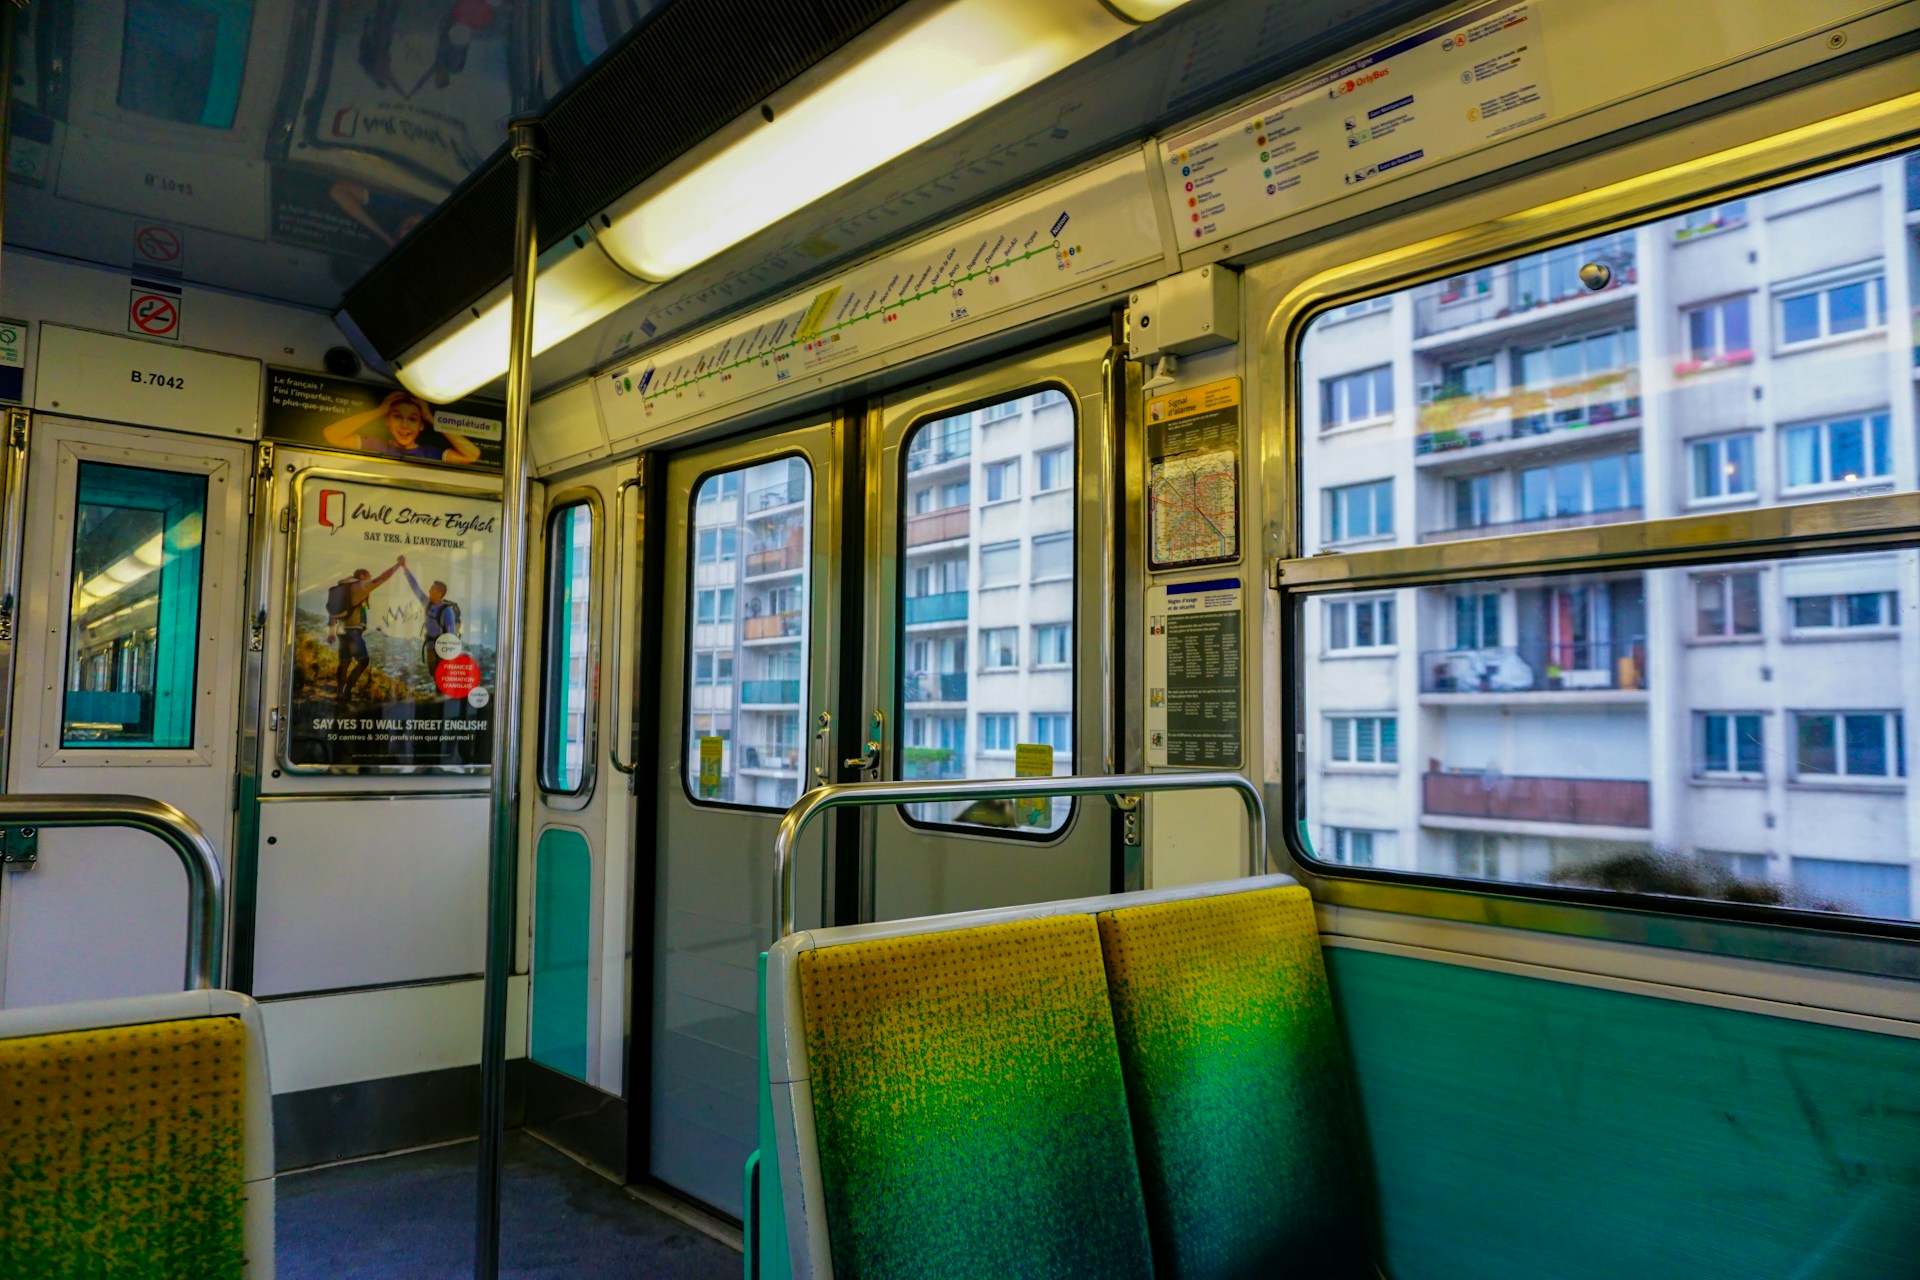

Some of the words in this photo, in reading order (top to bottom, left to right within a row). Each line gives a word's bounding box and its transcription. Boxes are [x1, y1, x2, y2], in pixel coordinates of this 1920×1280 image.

[1356, 68, 1389, 86] OrlyBus
[1052, 213, 1069, 236] Nation
[1004, 237, 1019, 257] Bel-Air
[1024, 230, 1039, 249] Picpus
[931, 272, 941, 285] Quai
[947, 247, 957, 261] Gare
[949, 262, 960, 277] Bercy
[131, 370, 184, 390] B.7042
[275, 376, 285, 384] Le
[287, 377, 318, 390] français
[273, 396, 280, 405] le
[282, 398, 345, 414] plus-que-parfait
[274, 386, 288, 395] Fini
[291, 388, 334, 402] l'imparfait,
[336, 397, 349, 406] cap
[1168, 395, 1188, 408] Signal
[1168, 404, 1197, 417] d'alarme
[437, 416, 491, 431] complétude
[351, 503, 392, 525] Wall
[395, 508, 443, 527] Street
[444, 513, 496, 536] English
[364, 531, 381, 542] SAY
[383, 533, 402, 544] YES.
[404, 533, 411, 544] À
[413, 536, 467, 550] L'AVENTURE.
[443, 663, 473, 671] FINANCEZ
[312, 718, 334, 730] SAY
[336, 718, 357, 730] YES
[360, 719, 374, 730] TO
[375, 719, 403, 731] WALL
[405, 719, 442, 731] STREET
[444, 719, 487, 731] ENGLISH!
[390, 734, 409, 742] profs
